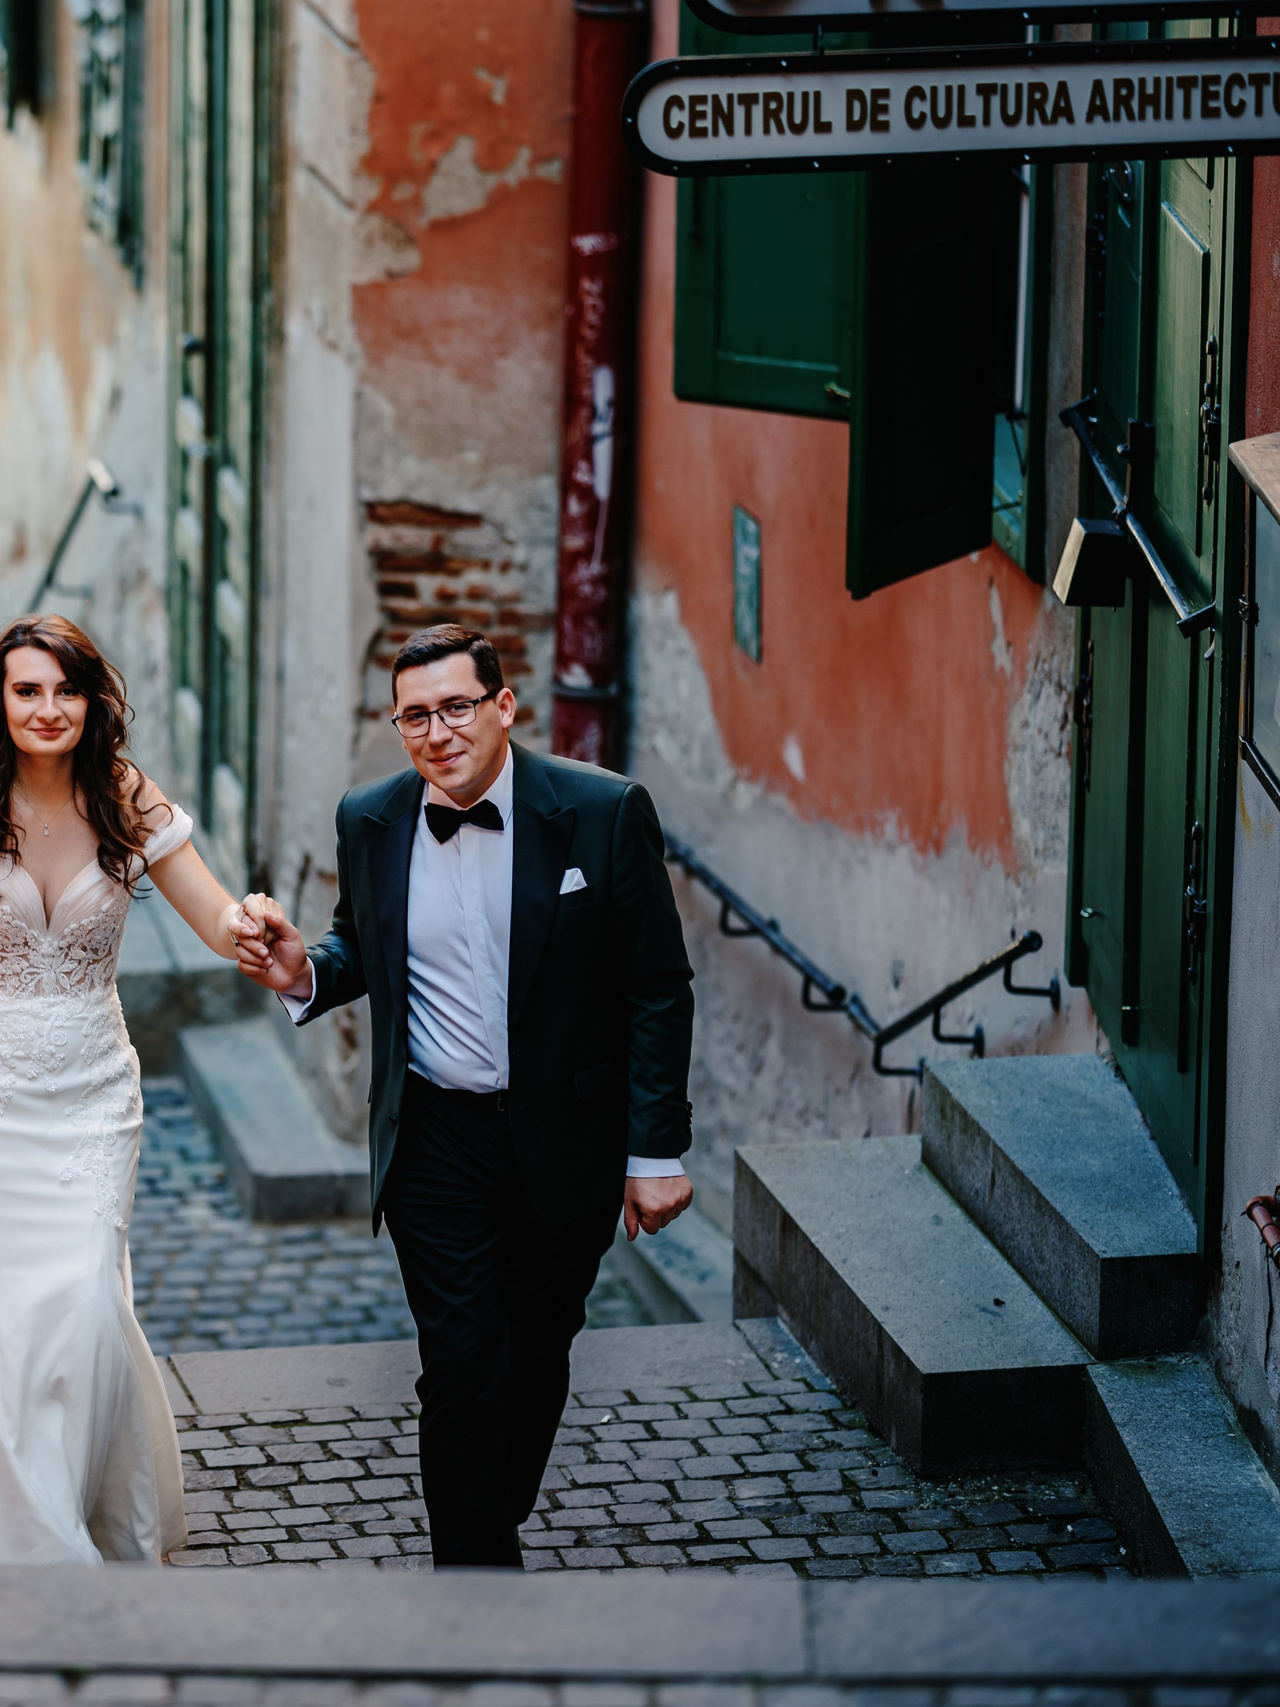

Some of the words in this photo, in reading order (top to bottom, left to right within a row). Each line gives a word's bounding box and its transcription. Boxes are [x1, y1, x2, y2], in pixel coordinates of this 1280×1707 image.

[662, 90, 833, 140] CENTRUL
[845, 88, 891, 133] DE
[904, 80, 1076, 130] CULTURA
